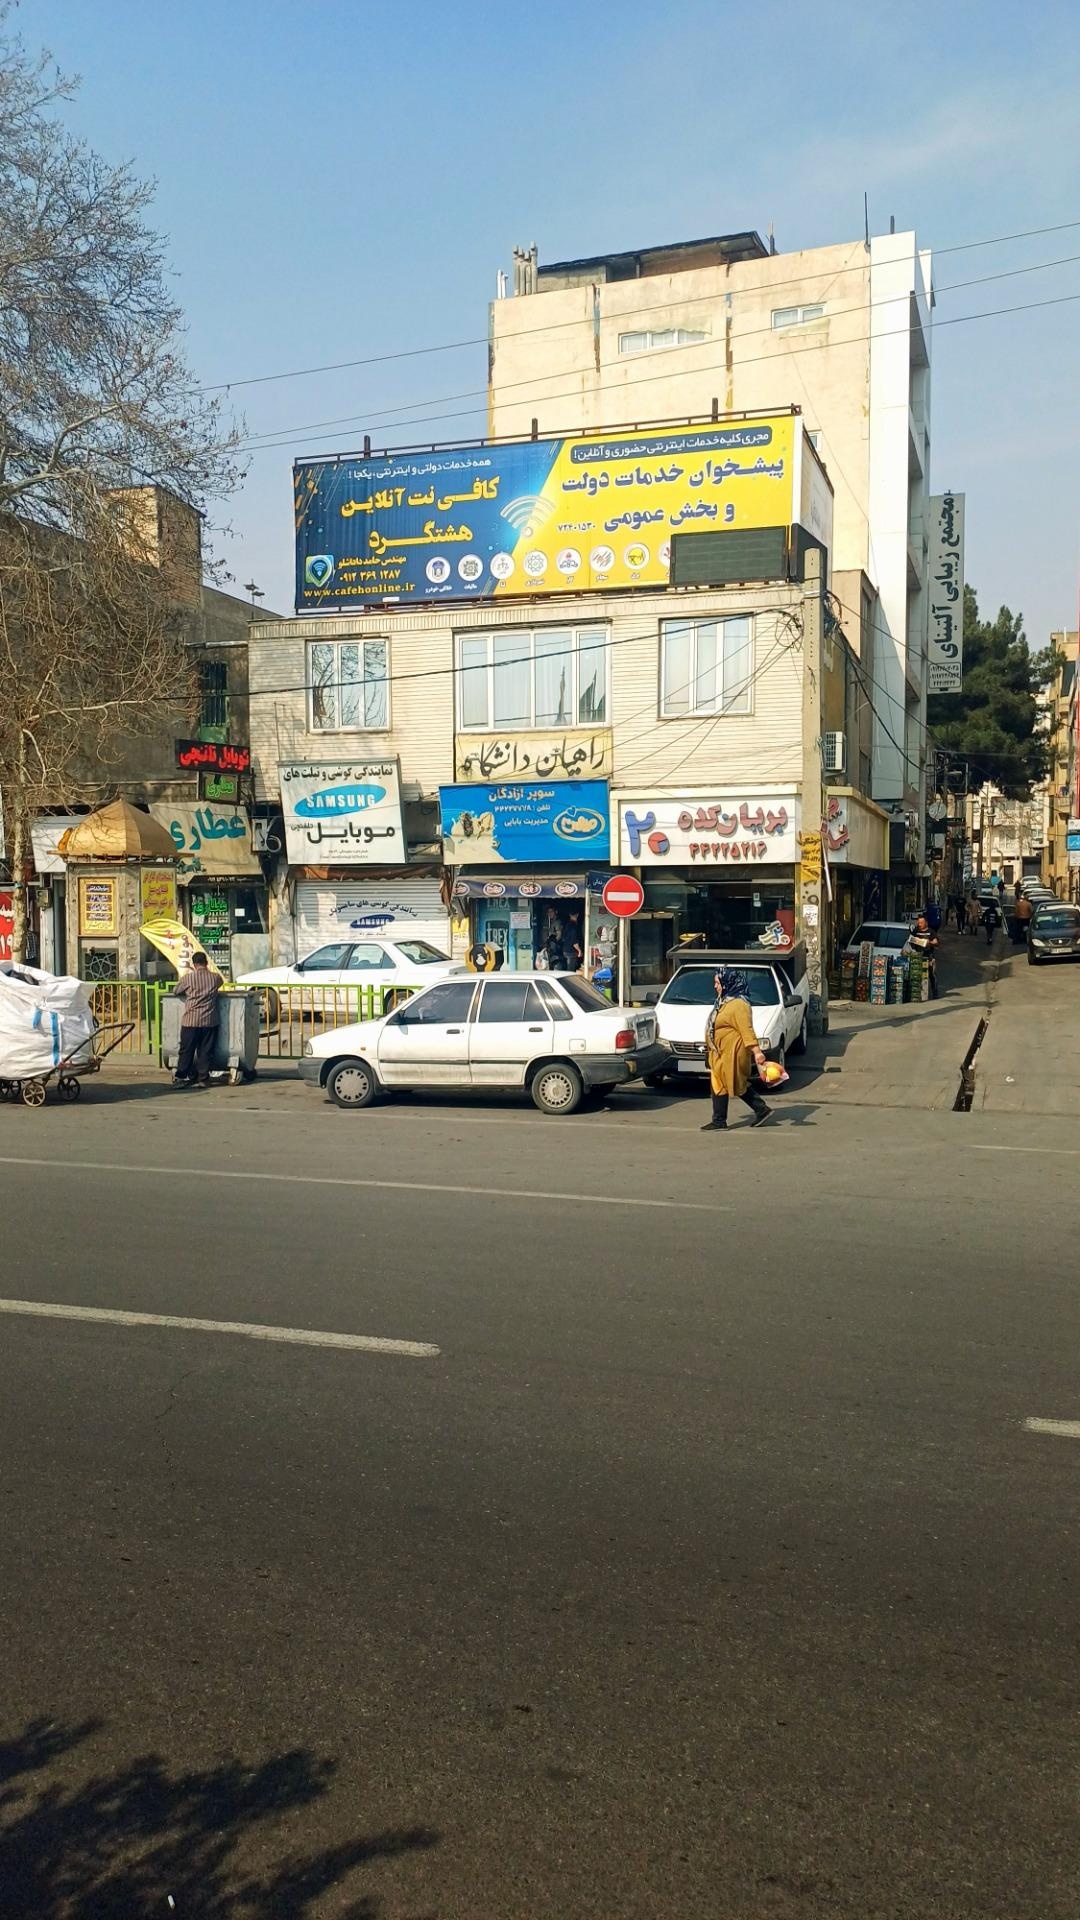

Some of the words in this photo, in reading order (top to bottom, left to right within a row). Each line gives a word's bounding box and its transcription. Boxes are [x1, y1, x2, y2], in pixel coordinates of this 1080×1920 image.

[647, 438, 685, 455] اینترنتی
[687, 437, 719, 449] خدمات
[720, 433, 742, 447] کلیه
[742, 432, 769, 445] مجری
[611, 443, 647, 459] حضوری
[417, 462, 442, 476] دولتی
[443, 460, 471, 471] خدمات
[473, 458, 492, 467] همه
[614, 464, 684, 488] خدمات
[689, 457, 784, 488] پیشخوان
[437, 475, 500, 511] کافی
[562, 472, 610, 496] دولت
[340, 487, 407, 517] آنلاین
[407, 486, 435, 507] نت
[603, 508, 665, 533] عمومی
[669, 499, 718, 526] بخش
[724, 502, 735, 522] و
[939, 496, 960, 547] مجتمع
[369, 521, 474, 555] هشتگرد
[380, 555, 407, 567] مهندس
[304, 583, 416, 598] www.cafehonline.ir
[457, 741, 531, 777] دانشگاه
[536, 736, 605, 777] راهیان
[283, 767, 300, 781] های
[354, 764, 393, 780] نمایندگی
[306, 794, 376, 808] SAMSUNG
[526, 789, 555, 801] سوپر
[170, 807, 246, 850] عطاری
[523, 817, 549, 825] مدیریت
[307, 822, 395, 844] موبایل
